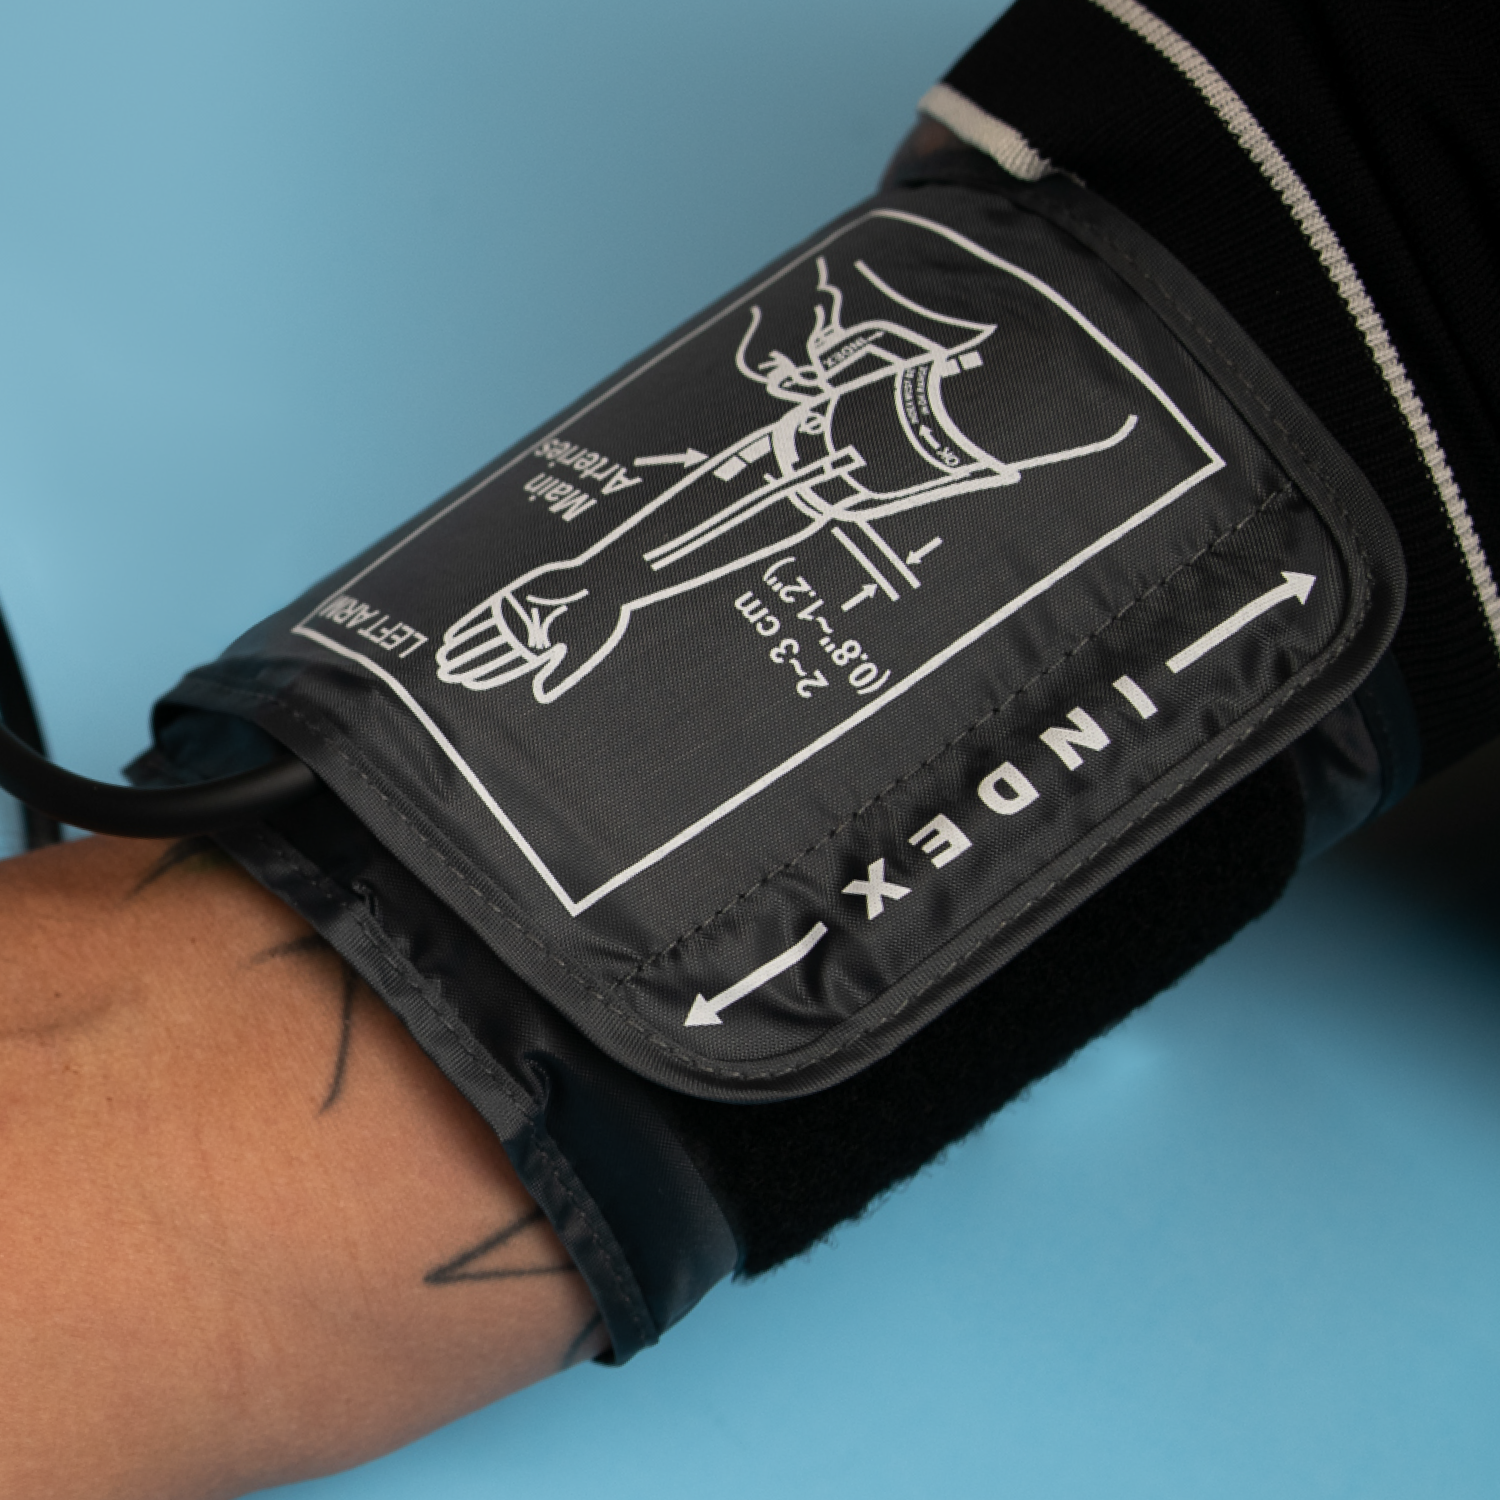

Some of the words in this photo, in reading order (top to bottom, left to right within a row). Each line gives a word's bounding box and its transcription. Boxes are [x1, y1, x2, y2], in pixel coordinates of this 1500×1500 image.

[534, 438, 642, 495] Arteries
[936, 447, 961, 468] OK
[523, 472, 597, 522] Main
[357, 614, 429, 658] LEFT
[734, 591, 780, 636] cm
[841, 674, 1159, 921] INDEX
